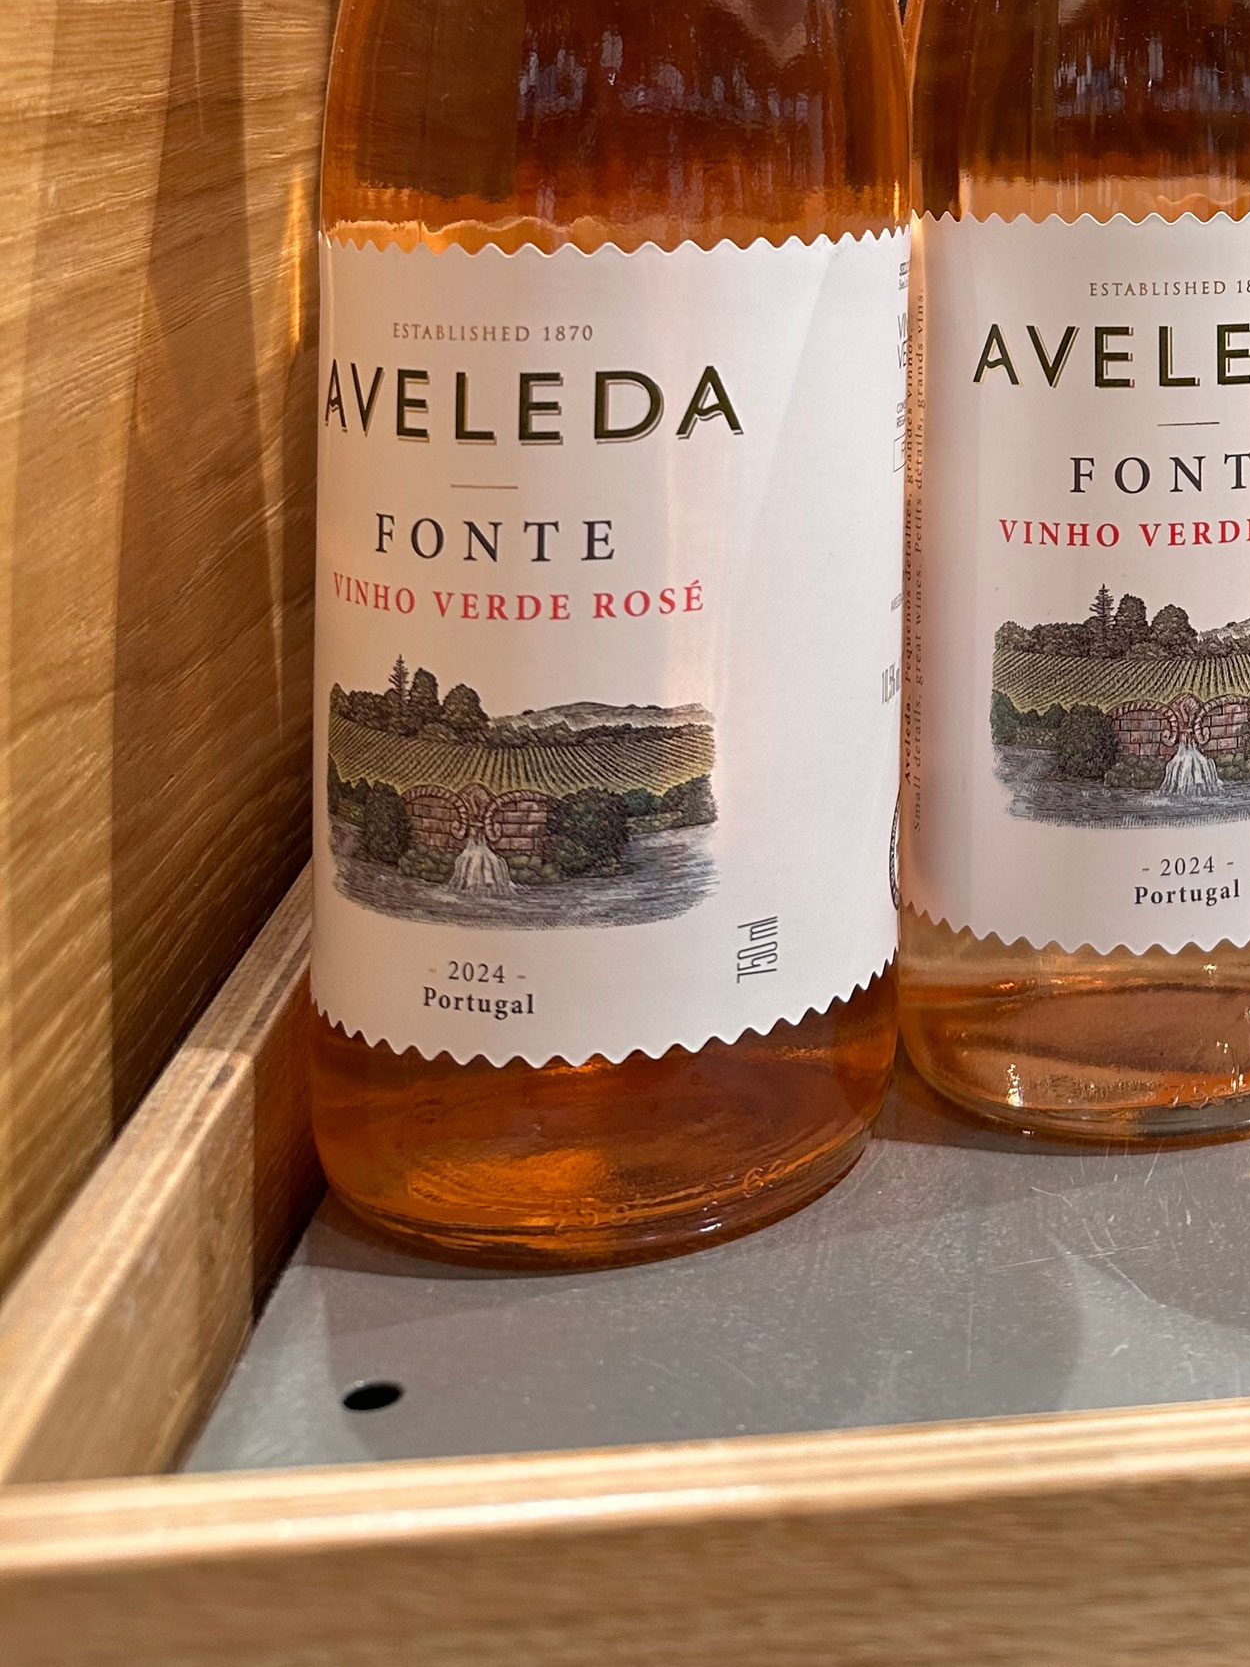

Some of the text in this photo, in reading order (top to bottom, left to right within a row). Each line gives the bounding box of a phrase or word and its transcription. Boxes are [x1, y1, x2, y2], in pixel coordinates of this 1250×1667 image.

[1089, 280, 1227, 298] ESTABLISHED
[392, 321, 594, 343] ESTABLISHED 1870
[325, 358, 745, 446] AVELEDA
[375, 512, 616, 563] FONTE
[999, 518, 1121, 548] VINHO
[333, 571, 706, 621] VINHO VERDE ROSÉ
[1160, 855, 1216, 877] 2024
[1134, 878, 1241, 907] Portugal
[447, 960, 507, 984] 2024
[422, 986, 536, 1020] Portugal
